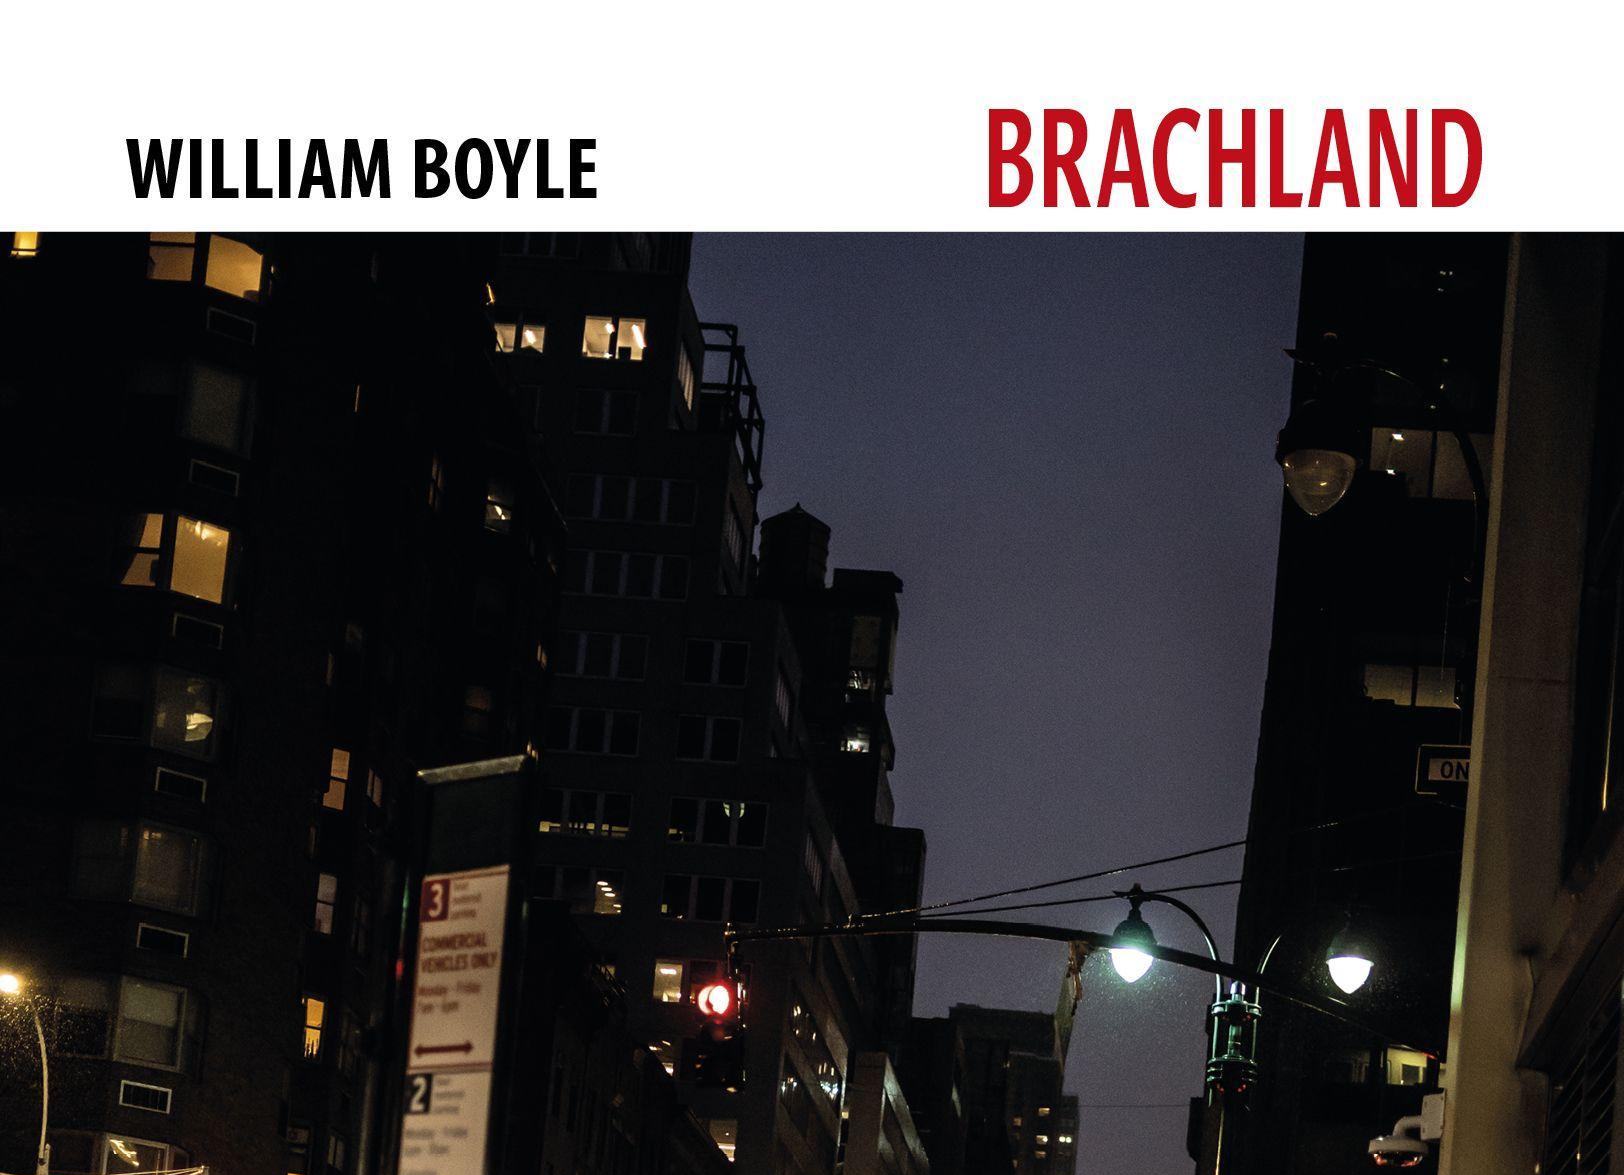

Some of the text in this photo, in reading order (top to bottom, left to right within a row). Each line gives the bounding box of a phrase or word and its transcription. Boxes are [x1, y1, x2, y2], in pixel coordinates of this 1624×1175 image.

[1440, 761, 1469, 780] ON
[428, 882, 444, 918] 3
[408, 1076, 427, 1113] 2
